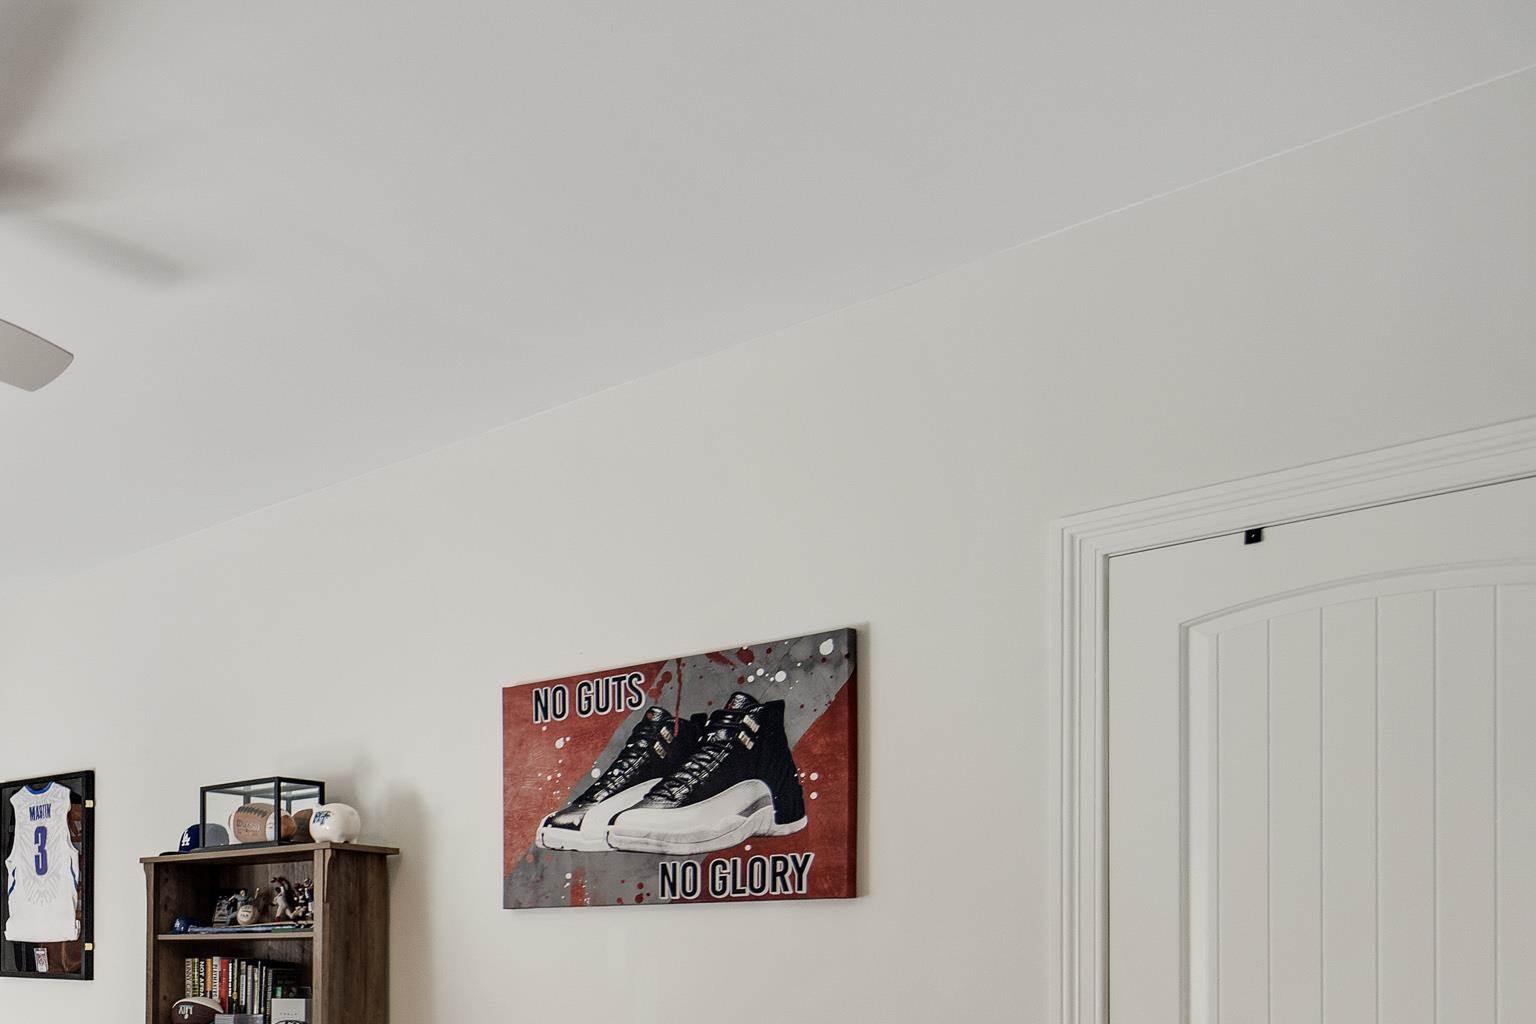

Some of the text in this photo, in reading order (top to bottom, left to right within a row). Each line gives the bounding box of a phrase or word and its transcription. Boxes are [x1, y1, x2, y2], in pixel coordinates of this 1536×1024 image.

[532, 671, 645, 724] NO GUTS
[29, 803, 51, 821] MARTIN
[34, 825, 48, 876] 3
[181, 830, 191, 847] LA
[658, 852, 814, 900] NO GLORY
